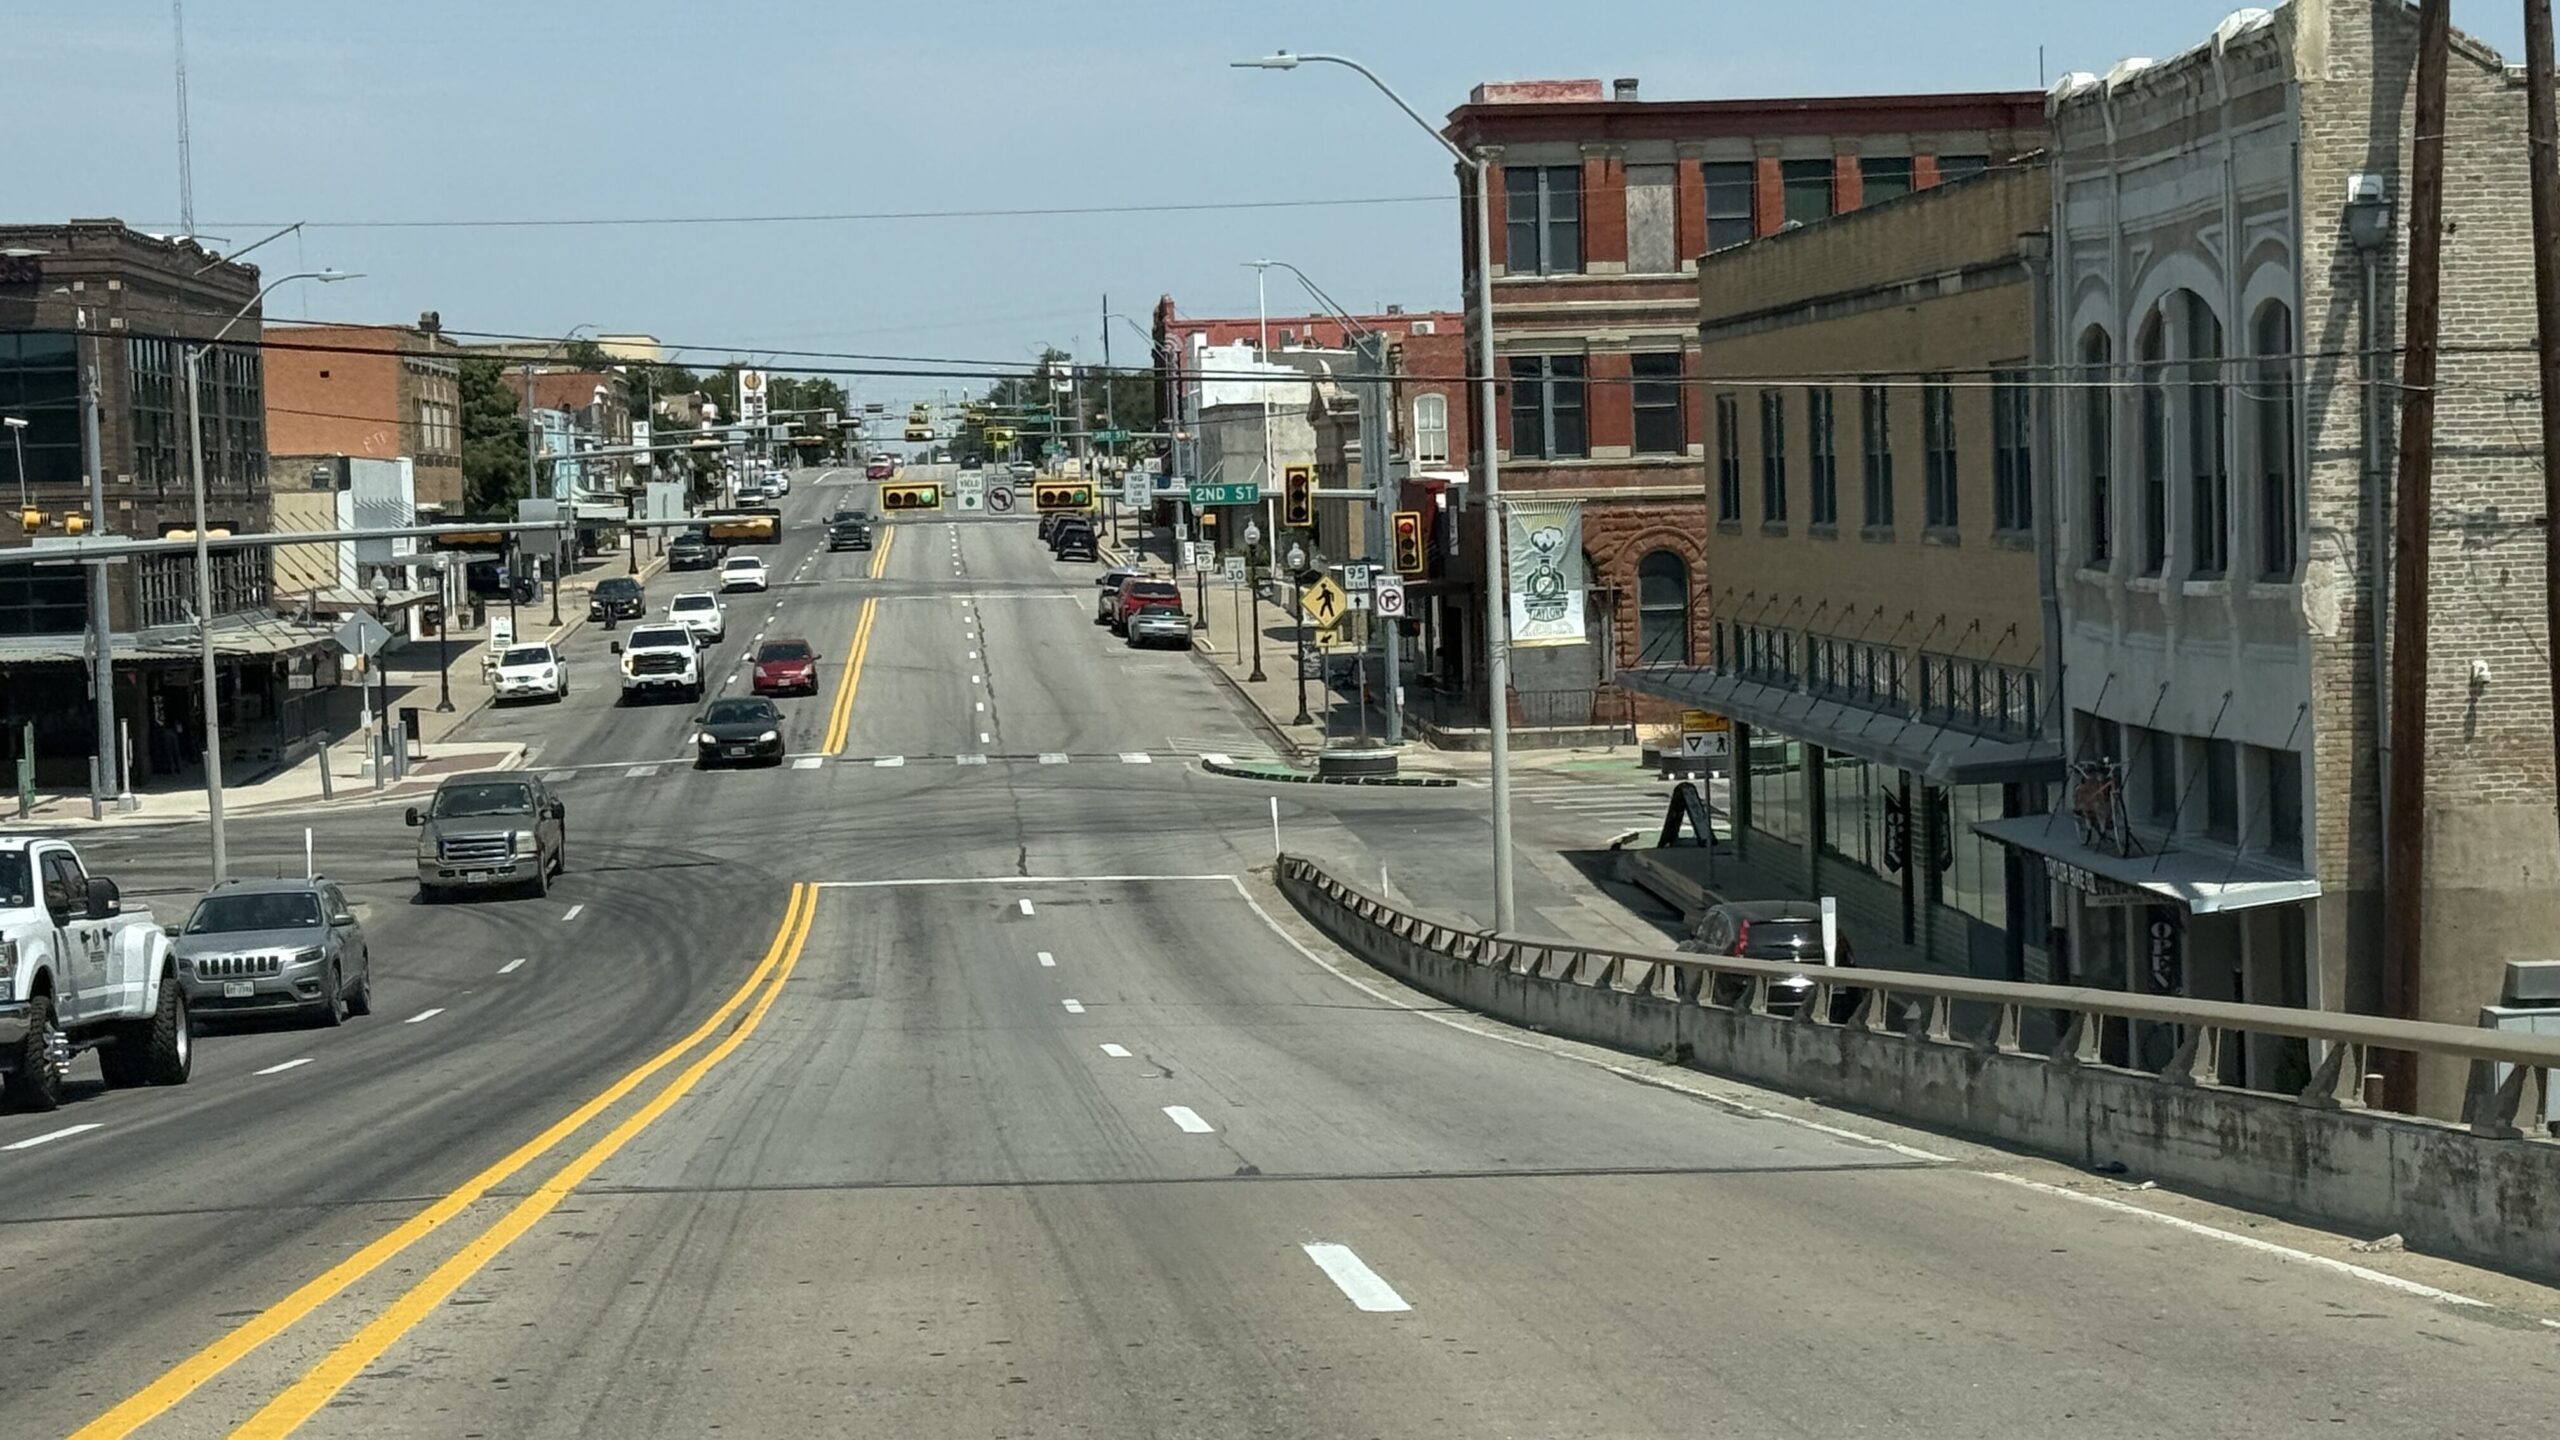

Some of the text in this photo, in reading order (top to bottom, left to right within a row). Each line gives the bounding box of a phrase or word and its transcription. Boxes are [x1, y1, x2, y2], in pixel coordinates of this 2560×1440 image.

[1115, 431, 1127, 439] ST
[1195, 485, 1254, 501] 2ND ST
[1227, 570, 1244, 580] 30
[1347, 567, 1366, 579] 95
[1531, 607, 1563, 620] TAYLOR
